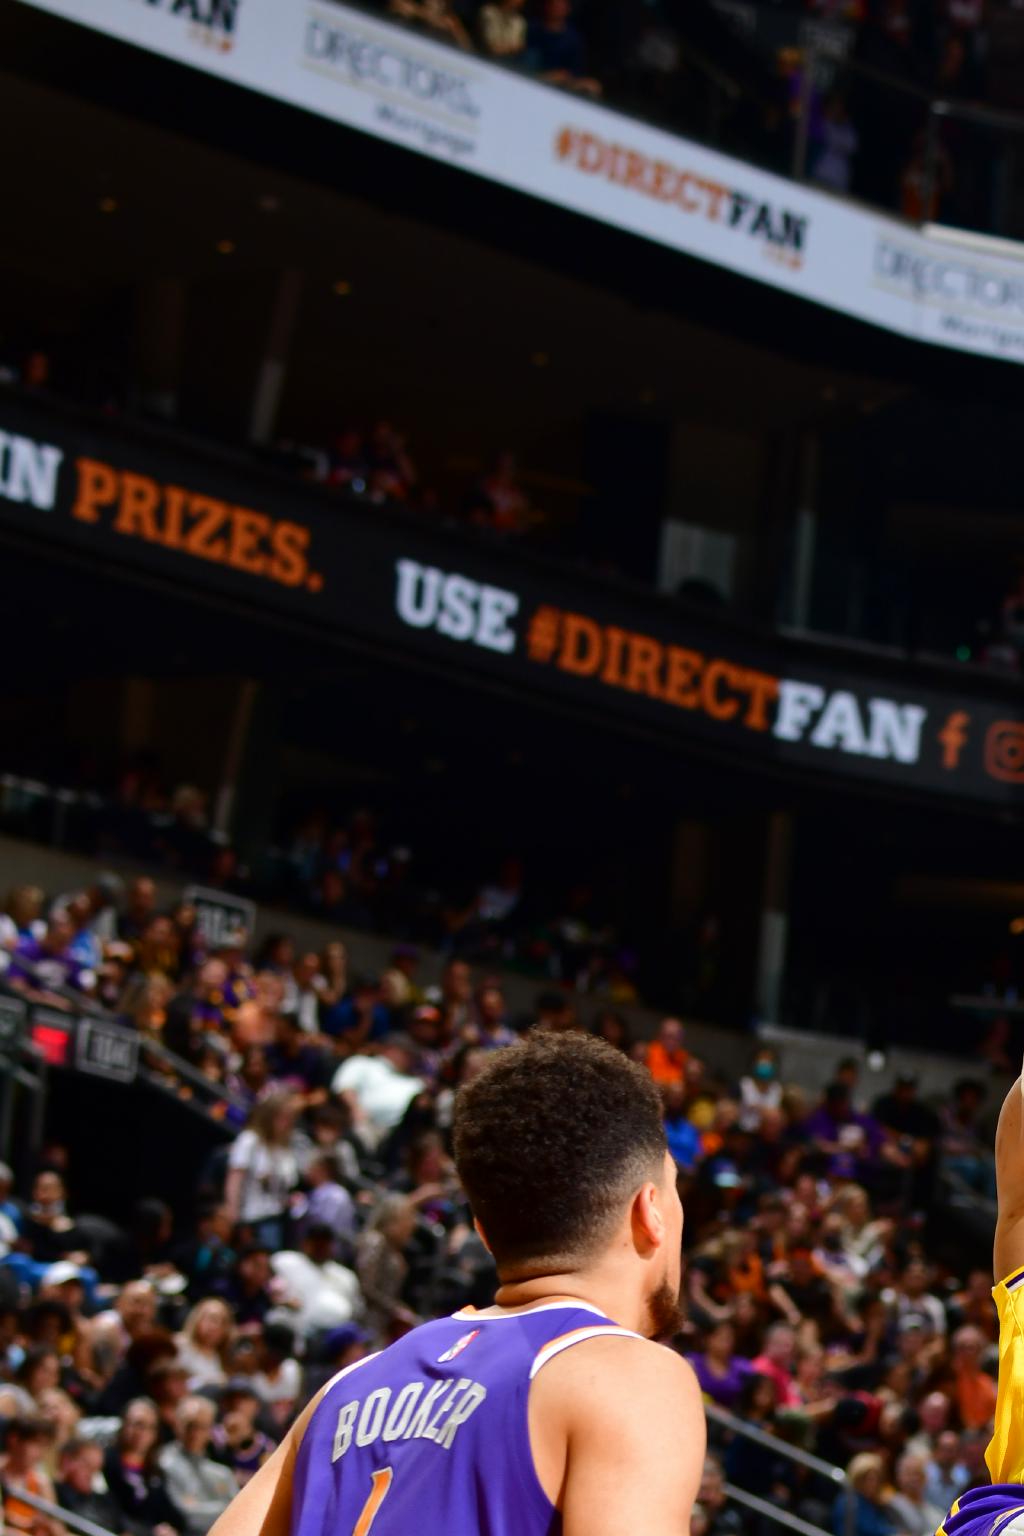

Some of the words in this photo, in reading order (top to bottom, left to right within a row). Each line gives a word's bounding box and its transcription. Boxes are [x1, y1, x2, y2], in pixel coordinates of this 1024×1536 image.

[554, 124, 808, 248] #DIRECTFAN
[72, 456, 324, 592] PRIZES.
[397, 558, 519, 653] USE
[527, 605, 925, 763] #DIRECTFAN
[331, 1378, 487, 1463] BOOKER
